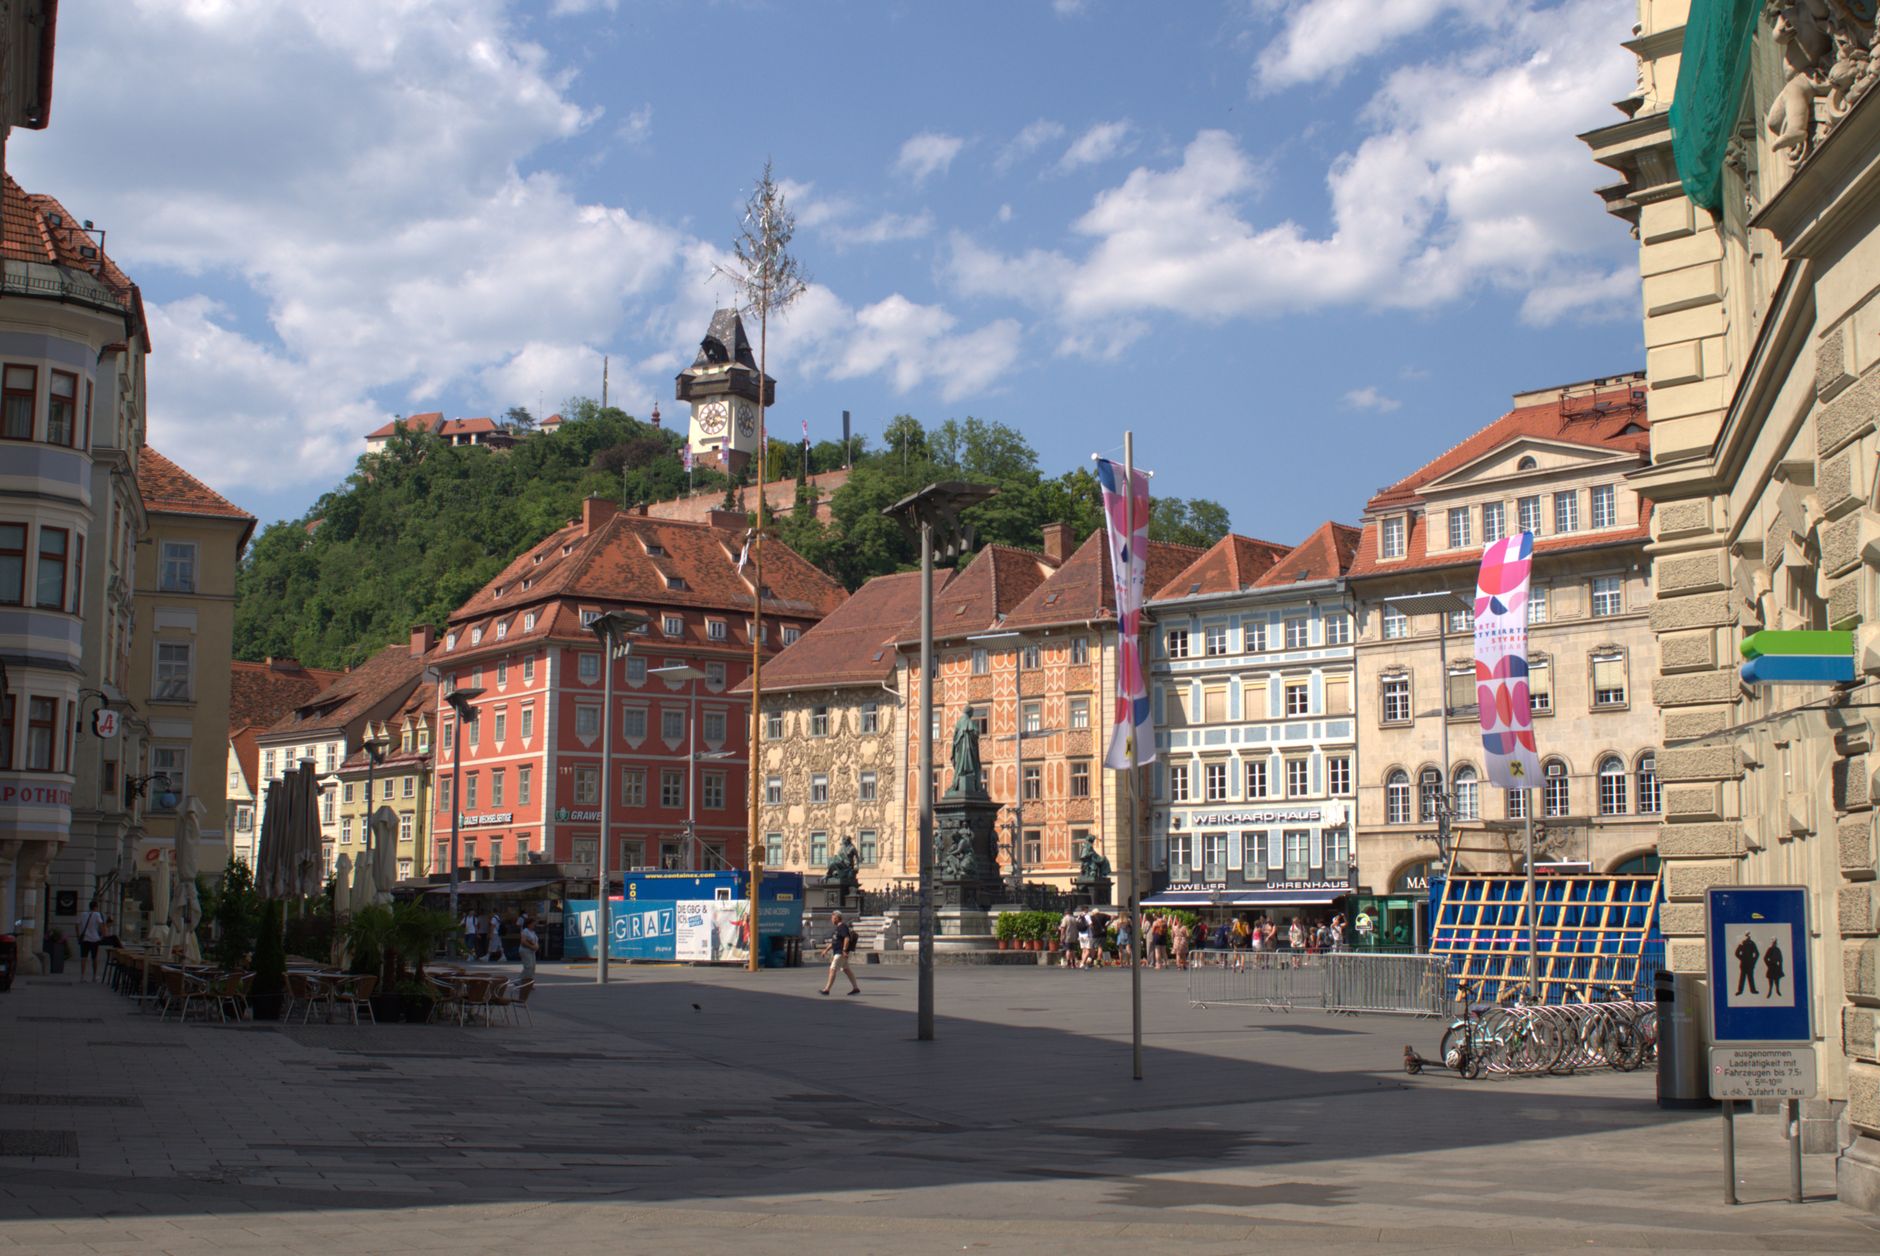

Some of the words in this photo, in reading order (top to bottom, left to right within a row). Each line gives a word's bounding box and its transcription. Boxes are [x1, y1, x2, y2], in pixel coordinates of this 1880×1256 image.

[1193, 812, 1275, 824] WEIKHARD
[1278, 811, 1321, 820] HAUS
[1166, 883, 1226, 891] JUWELIER
[1267, 881, 1349, 890] UHRENHAUS
[615, 912, 671, 939] GRAZ
[1734, 1050, 1792, 1059] ausgenommen
[1729, 1059, 1780, 1068] Ladetätigkeit
[1724, 1068, 1771, 1078] Fahrzeugen
[1748, 1088, 1774, 1096] Zufahrt
[1790, 1087, 1805, 1095] Taxi
